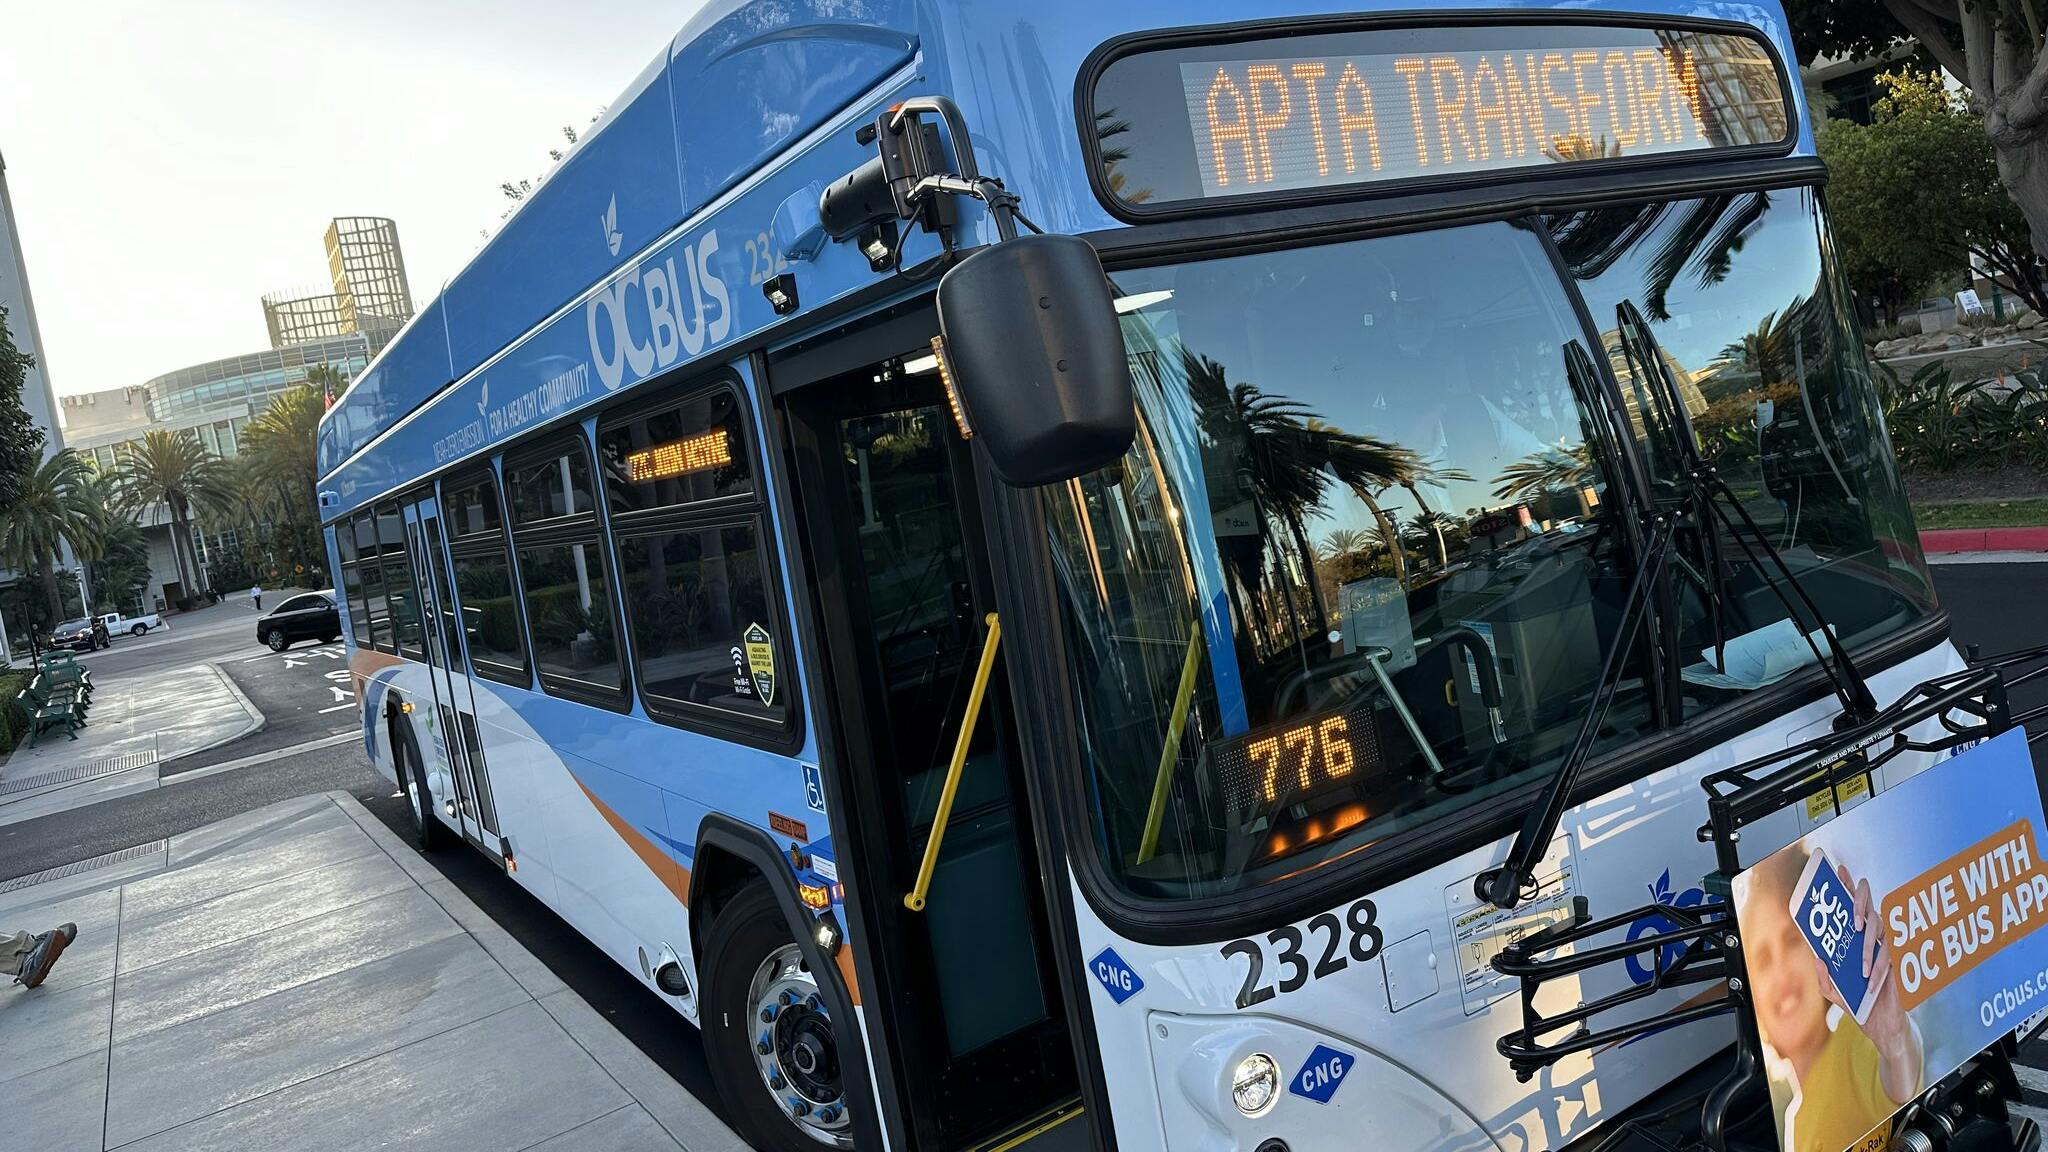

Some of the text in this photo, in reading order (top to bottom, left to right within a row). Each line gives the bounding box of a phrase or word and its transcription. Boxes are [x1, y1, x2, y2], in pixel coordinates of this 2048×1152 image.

[1206, 47, 1704, 187] APTA TRANSFORM
[744, 227, 800, 287] 232
[489, 409, 503, 438] FOR
[509, 389, 539, 429] HEALTHY
[538, 361, 591, 416] COMMUNITY
[1248, 715, 1355, 802] 776
[1809, 881, 1838, 938] OC
[1888, 834, 2032, 948] SAVE WITH
[1219, 898, 1384, 1010] 2328
[1820, 902, 1850, 960] BUS
[1831, 918, 1856, 972] MOBILE
[1899, 873, 2048, 994] OC BUS APP
[1097, 961, 1133, 992] CNG
[1301, 1057, 1343, 1093] CNG
